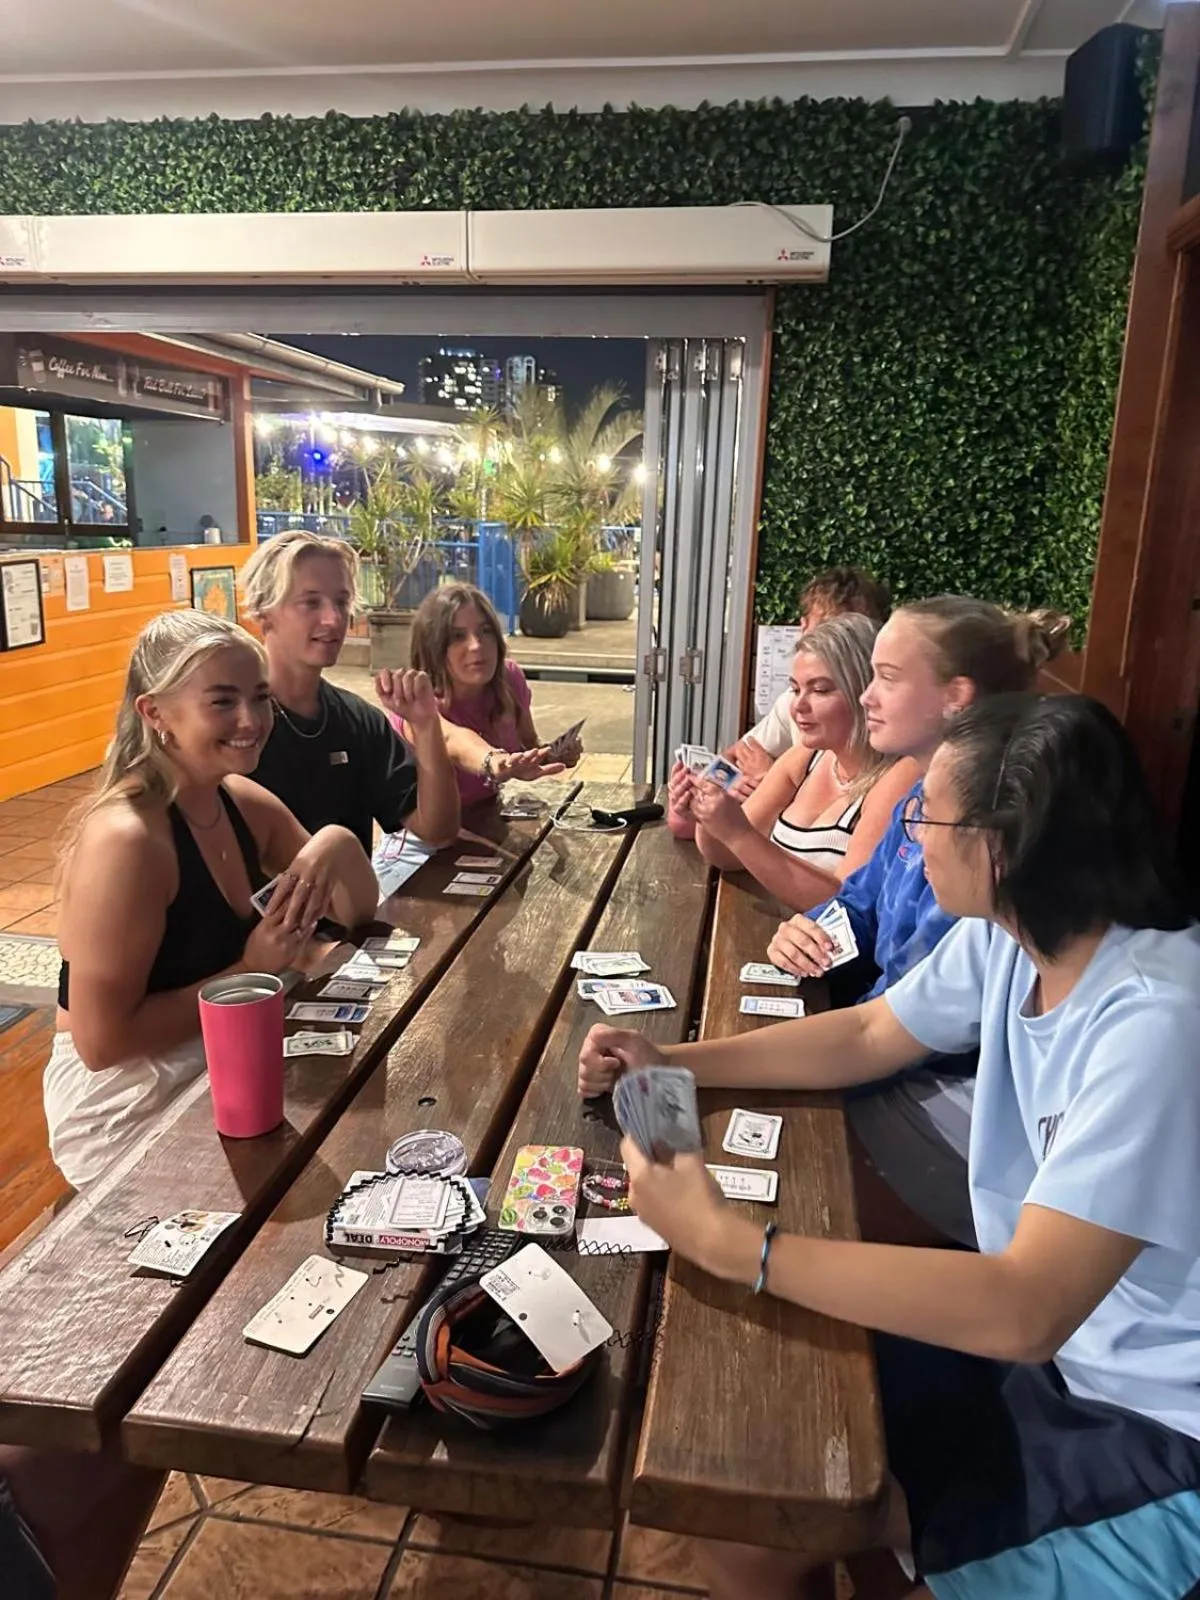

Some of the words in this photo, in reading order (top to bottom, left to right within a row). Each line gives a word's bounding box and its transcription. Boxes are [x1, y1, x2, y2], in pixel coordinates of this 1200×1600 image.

[49, 357, 75, 378] Coffee
[345, 1232, 373, 1244] DEAL
[380, 1235, 429, 1247] MONOPOLY
